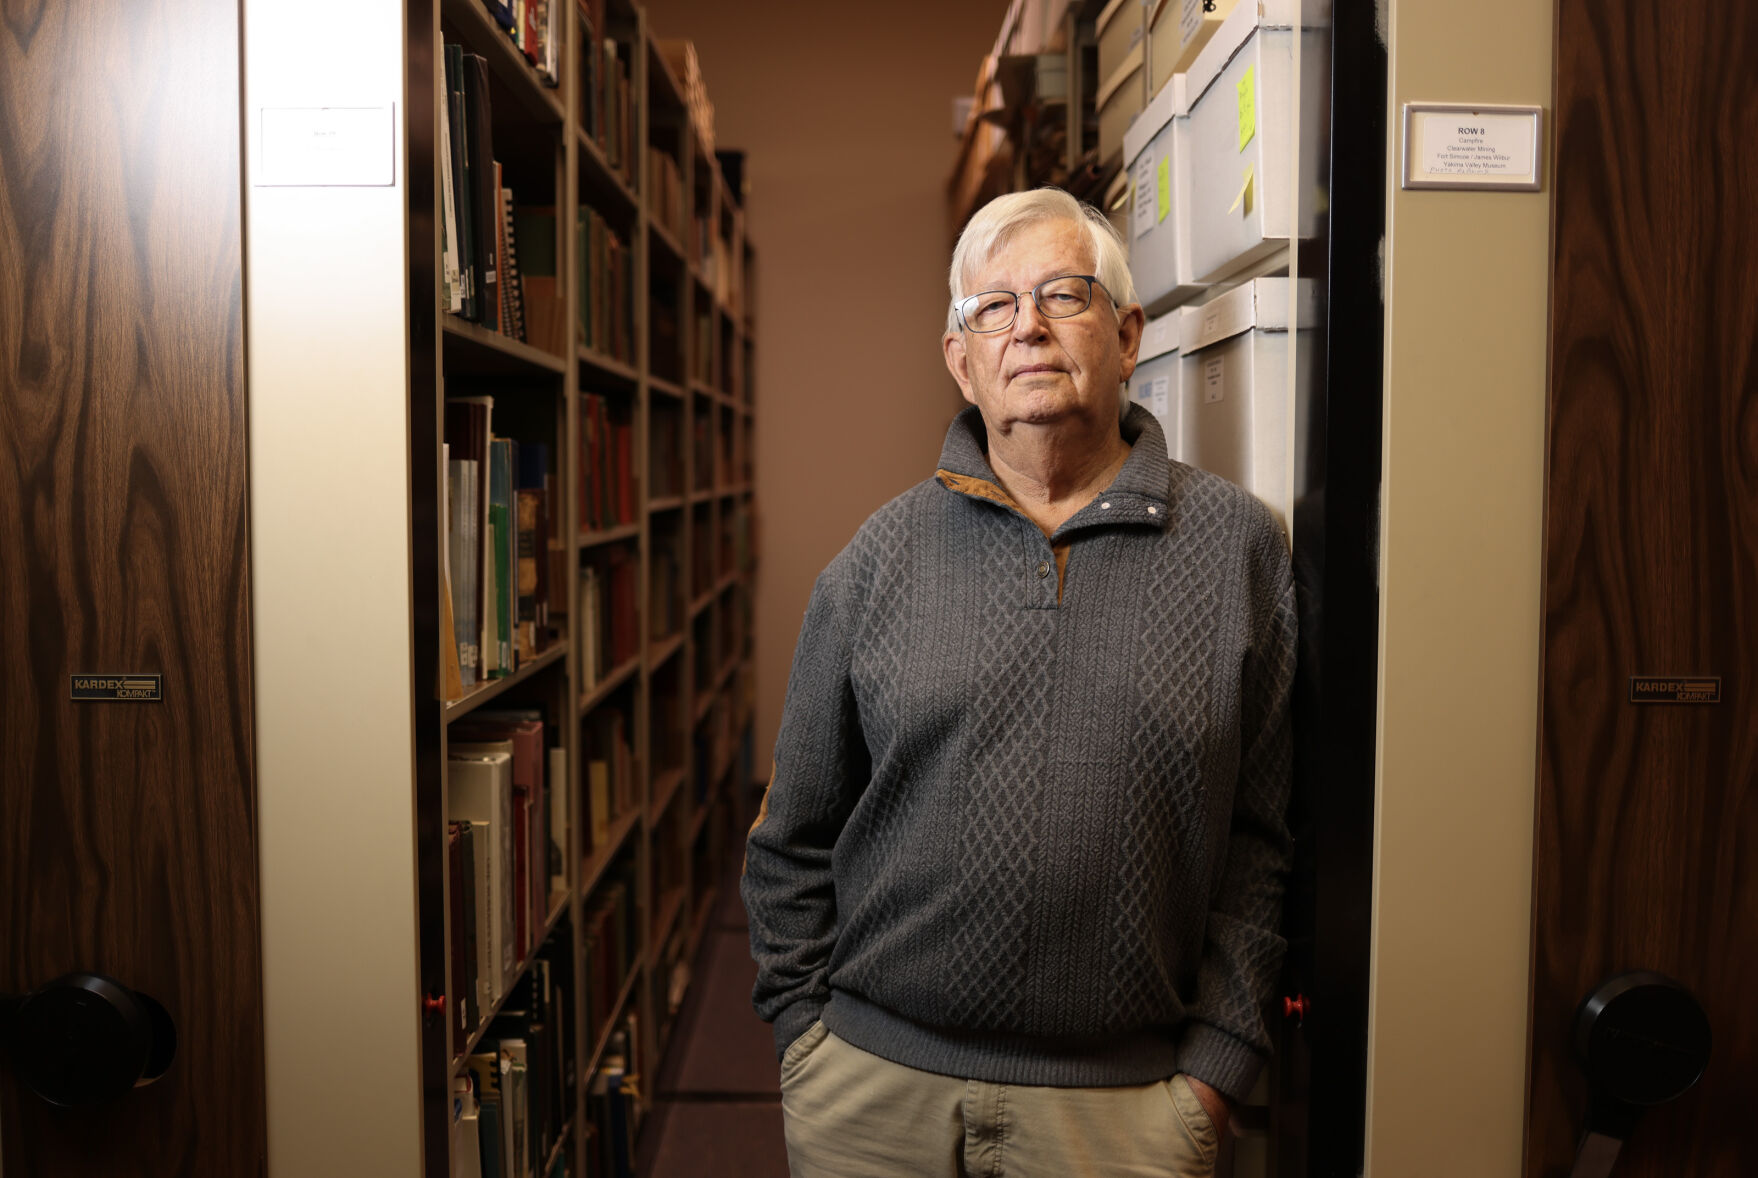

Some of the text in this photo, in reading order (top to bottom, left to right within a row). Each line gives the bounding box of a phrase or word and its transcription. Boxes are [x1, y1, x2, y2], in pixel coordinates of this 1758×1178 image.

[1458, 127, 1485, 135] ROW 8
[75, 680, 123, 689] KARDEX
[1636, 681, 1684, 692] KARDEX
